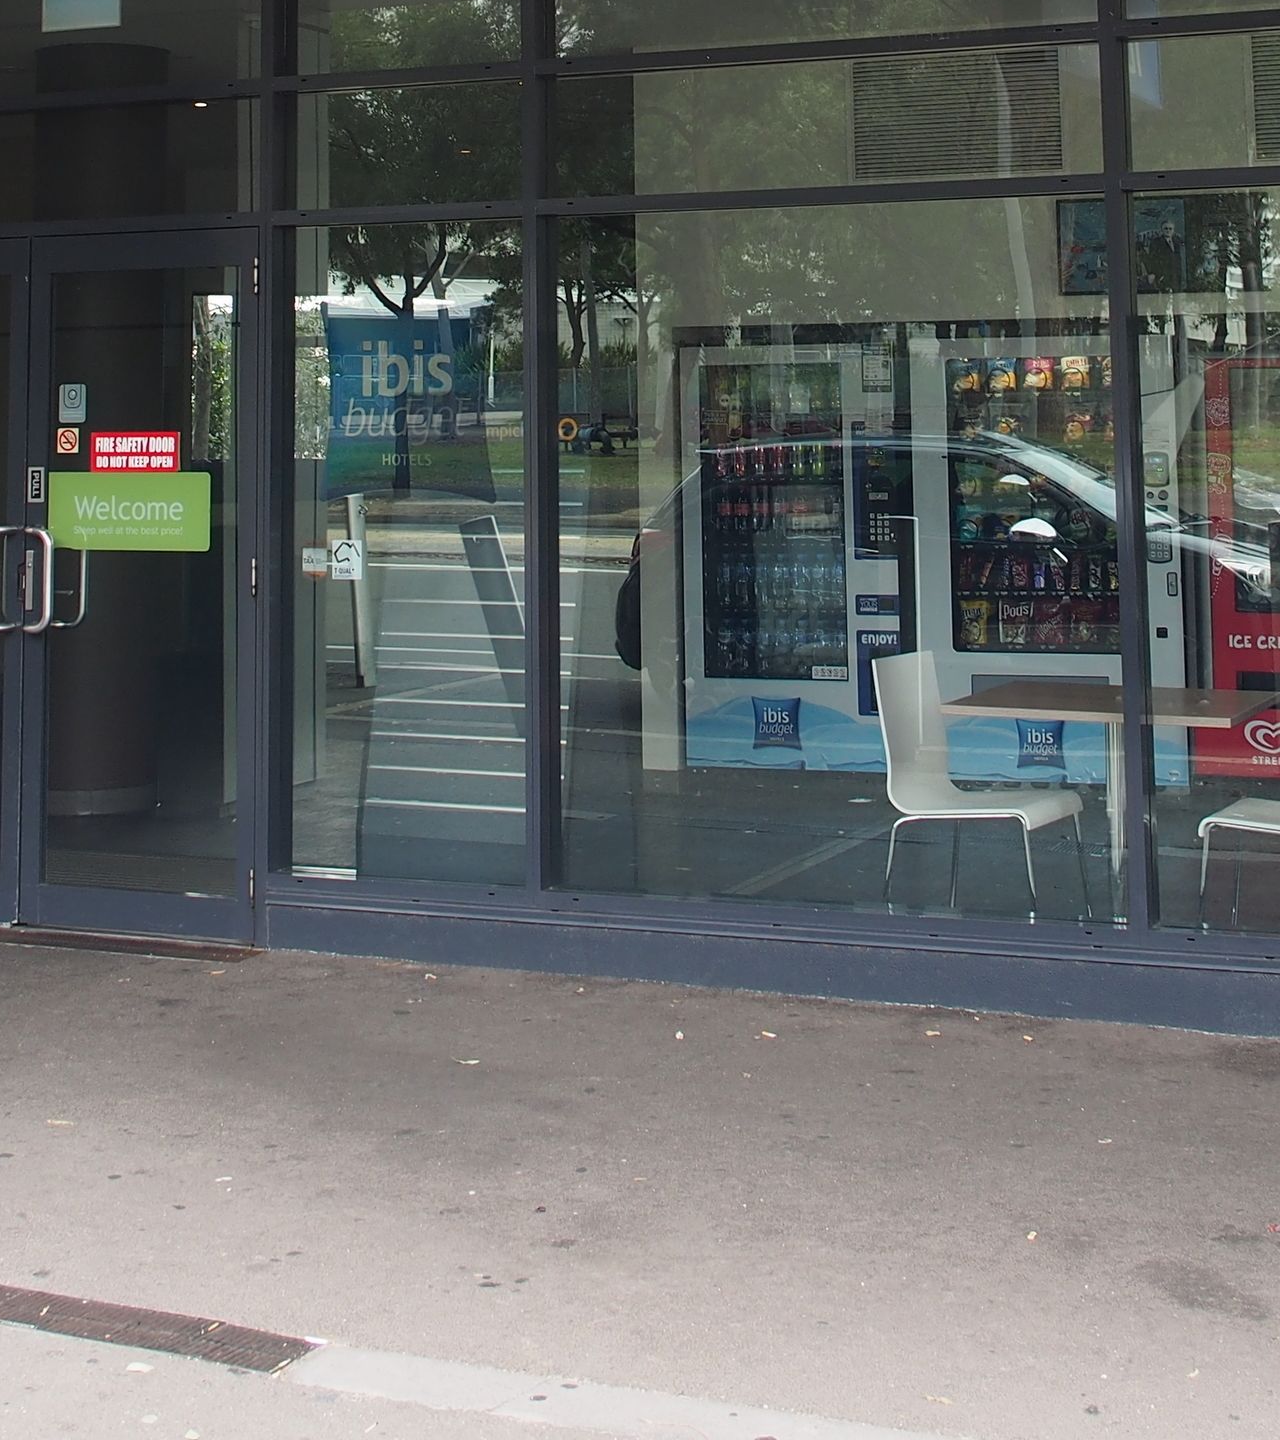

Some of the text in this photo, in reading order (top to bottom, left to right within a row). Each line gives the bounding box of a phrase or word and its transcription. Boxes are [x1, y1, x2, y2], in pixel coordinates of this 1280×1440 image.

[362, 339, 453, 398] ibis
[344, 398, 466, 446] budget
[95, 436, 175, 453] FIRE SAFETY DOOR
[96, 456, 174, 468] DO NOT KEEP OPEN
[382, 453, 432, 467] HOTELS
[32, 472, 40, 497] PULL
[73, 495, 184, 521] Welcome
[98, 526, 114, 536] well
[115, 527, 124, 536] at
[126, 526, 139, 536] the
[141, 526, 159, 536] best
[861, 633, 897, 647] ENJOY!
[1228, 634, 1252, 649] ICE
[763, 707, 789, 723] ibis
[759, 721, 794, 736] budget
[1027, 728, 1054, 744] ibis
[1023, 742, 1057, 756] budget
